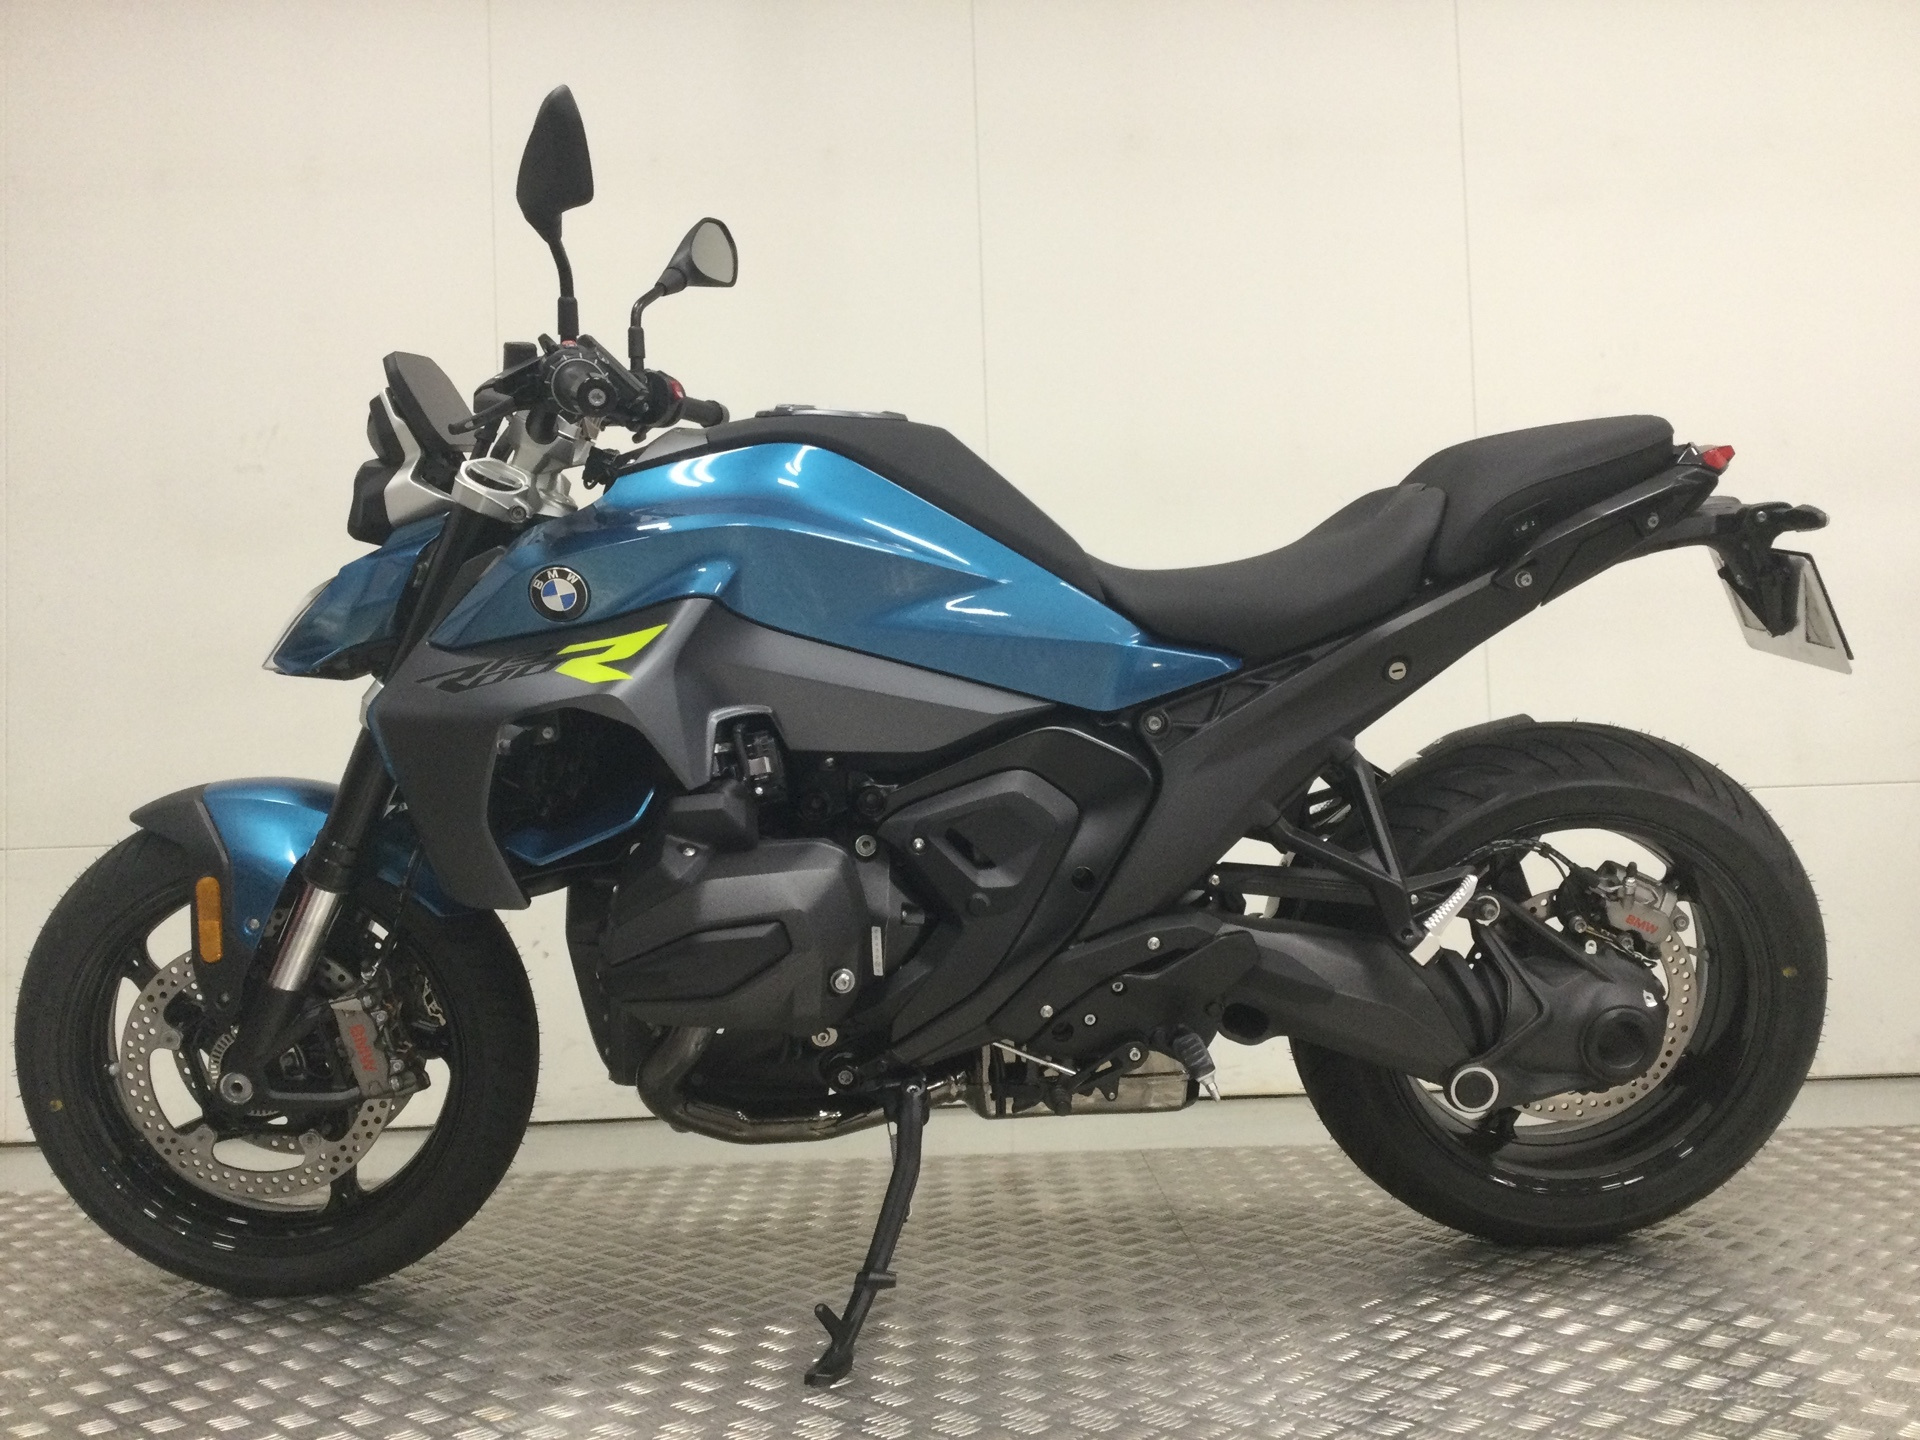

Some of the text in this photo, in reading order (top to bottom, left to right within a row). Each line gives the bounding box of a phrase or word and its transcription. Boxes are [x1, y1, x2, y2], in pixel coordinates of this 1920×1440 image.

[533, 570, 579, 590] BMW
[555, 623, 668, 684] R
[1626, 914, 1658, 934] BMW
[350, 1024, 377, 1072] BMW
